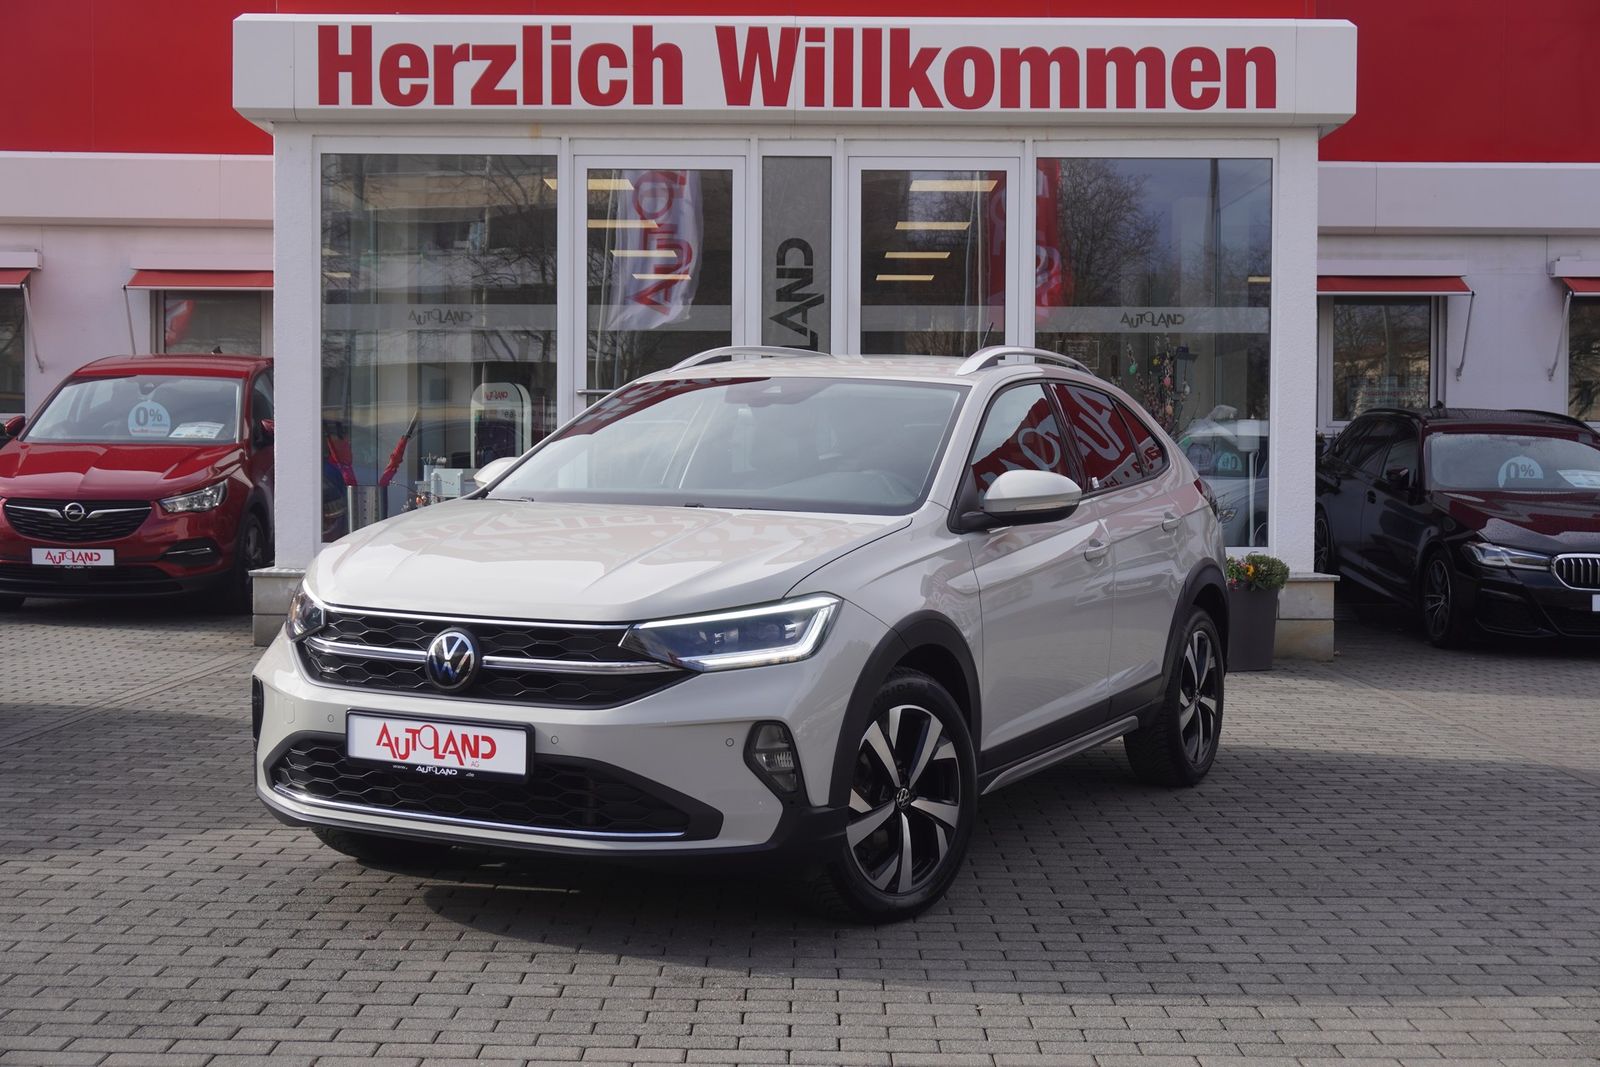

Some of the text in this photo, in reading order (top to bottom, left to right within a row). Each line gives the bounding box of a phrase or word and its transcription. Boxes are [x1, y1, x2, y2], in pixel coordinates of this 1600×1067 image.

[318, 25, 1276, 111] Herzlich Willkommen
[408, 308, 473, 326] AUTOLAND
[1119, 310, 1185, 328] AUTOLAND
[45, 549, 102, 564] AUTOLAND
[376, 722, 497, 766] AUTOLAND
[415, 764, 459, 777] AUTOLAND
